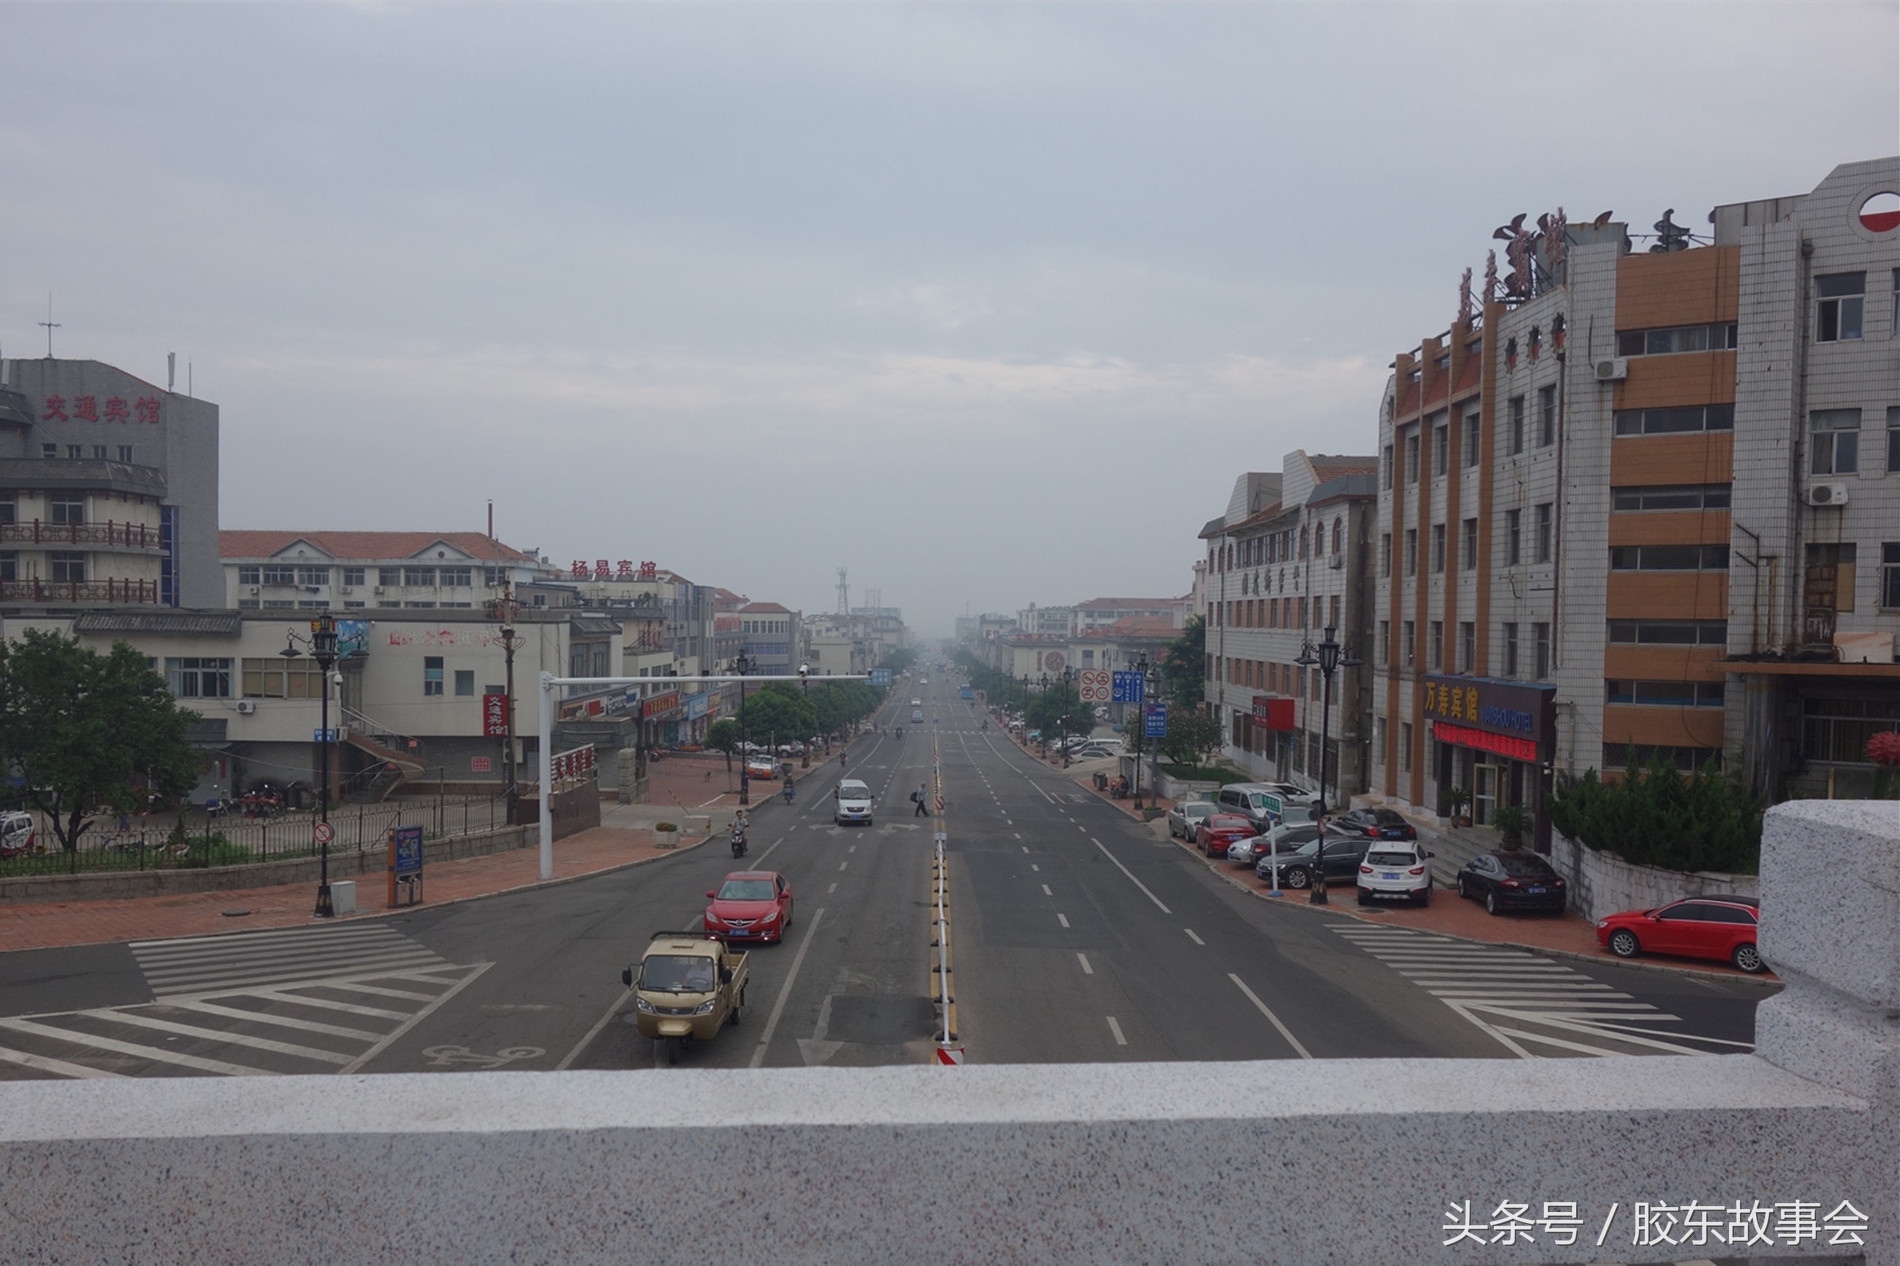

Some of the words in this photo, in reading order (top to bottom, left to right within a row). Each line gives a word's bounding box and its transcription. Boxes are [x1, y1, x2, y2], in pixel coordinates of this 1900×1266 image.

[42, 395, 161, 424] 交通宾馆
[571, 559, 657, 577] 杨易宾馆
[488, 696, 502, 734] 交通宾馆
[1425, 682, 1480, 722] 万寿宾馆
[1511, 711, 1532, 732] HOTEL
